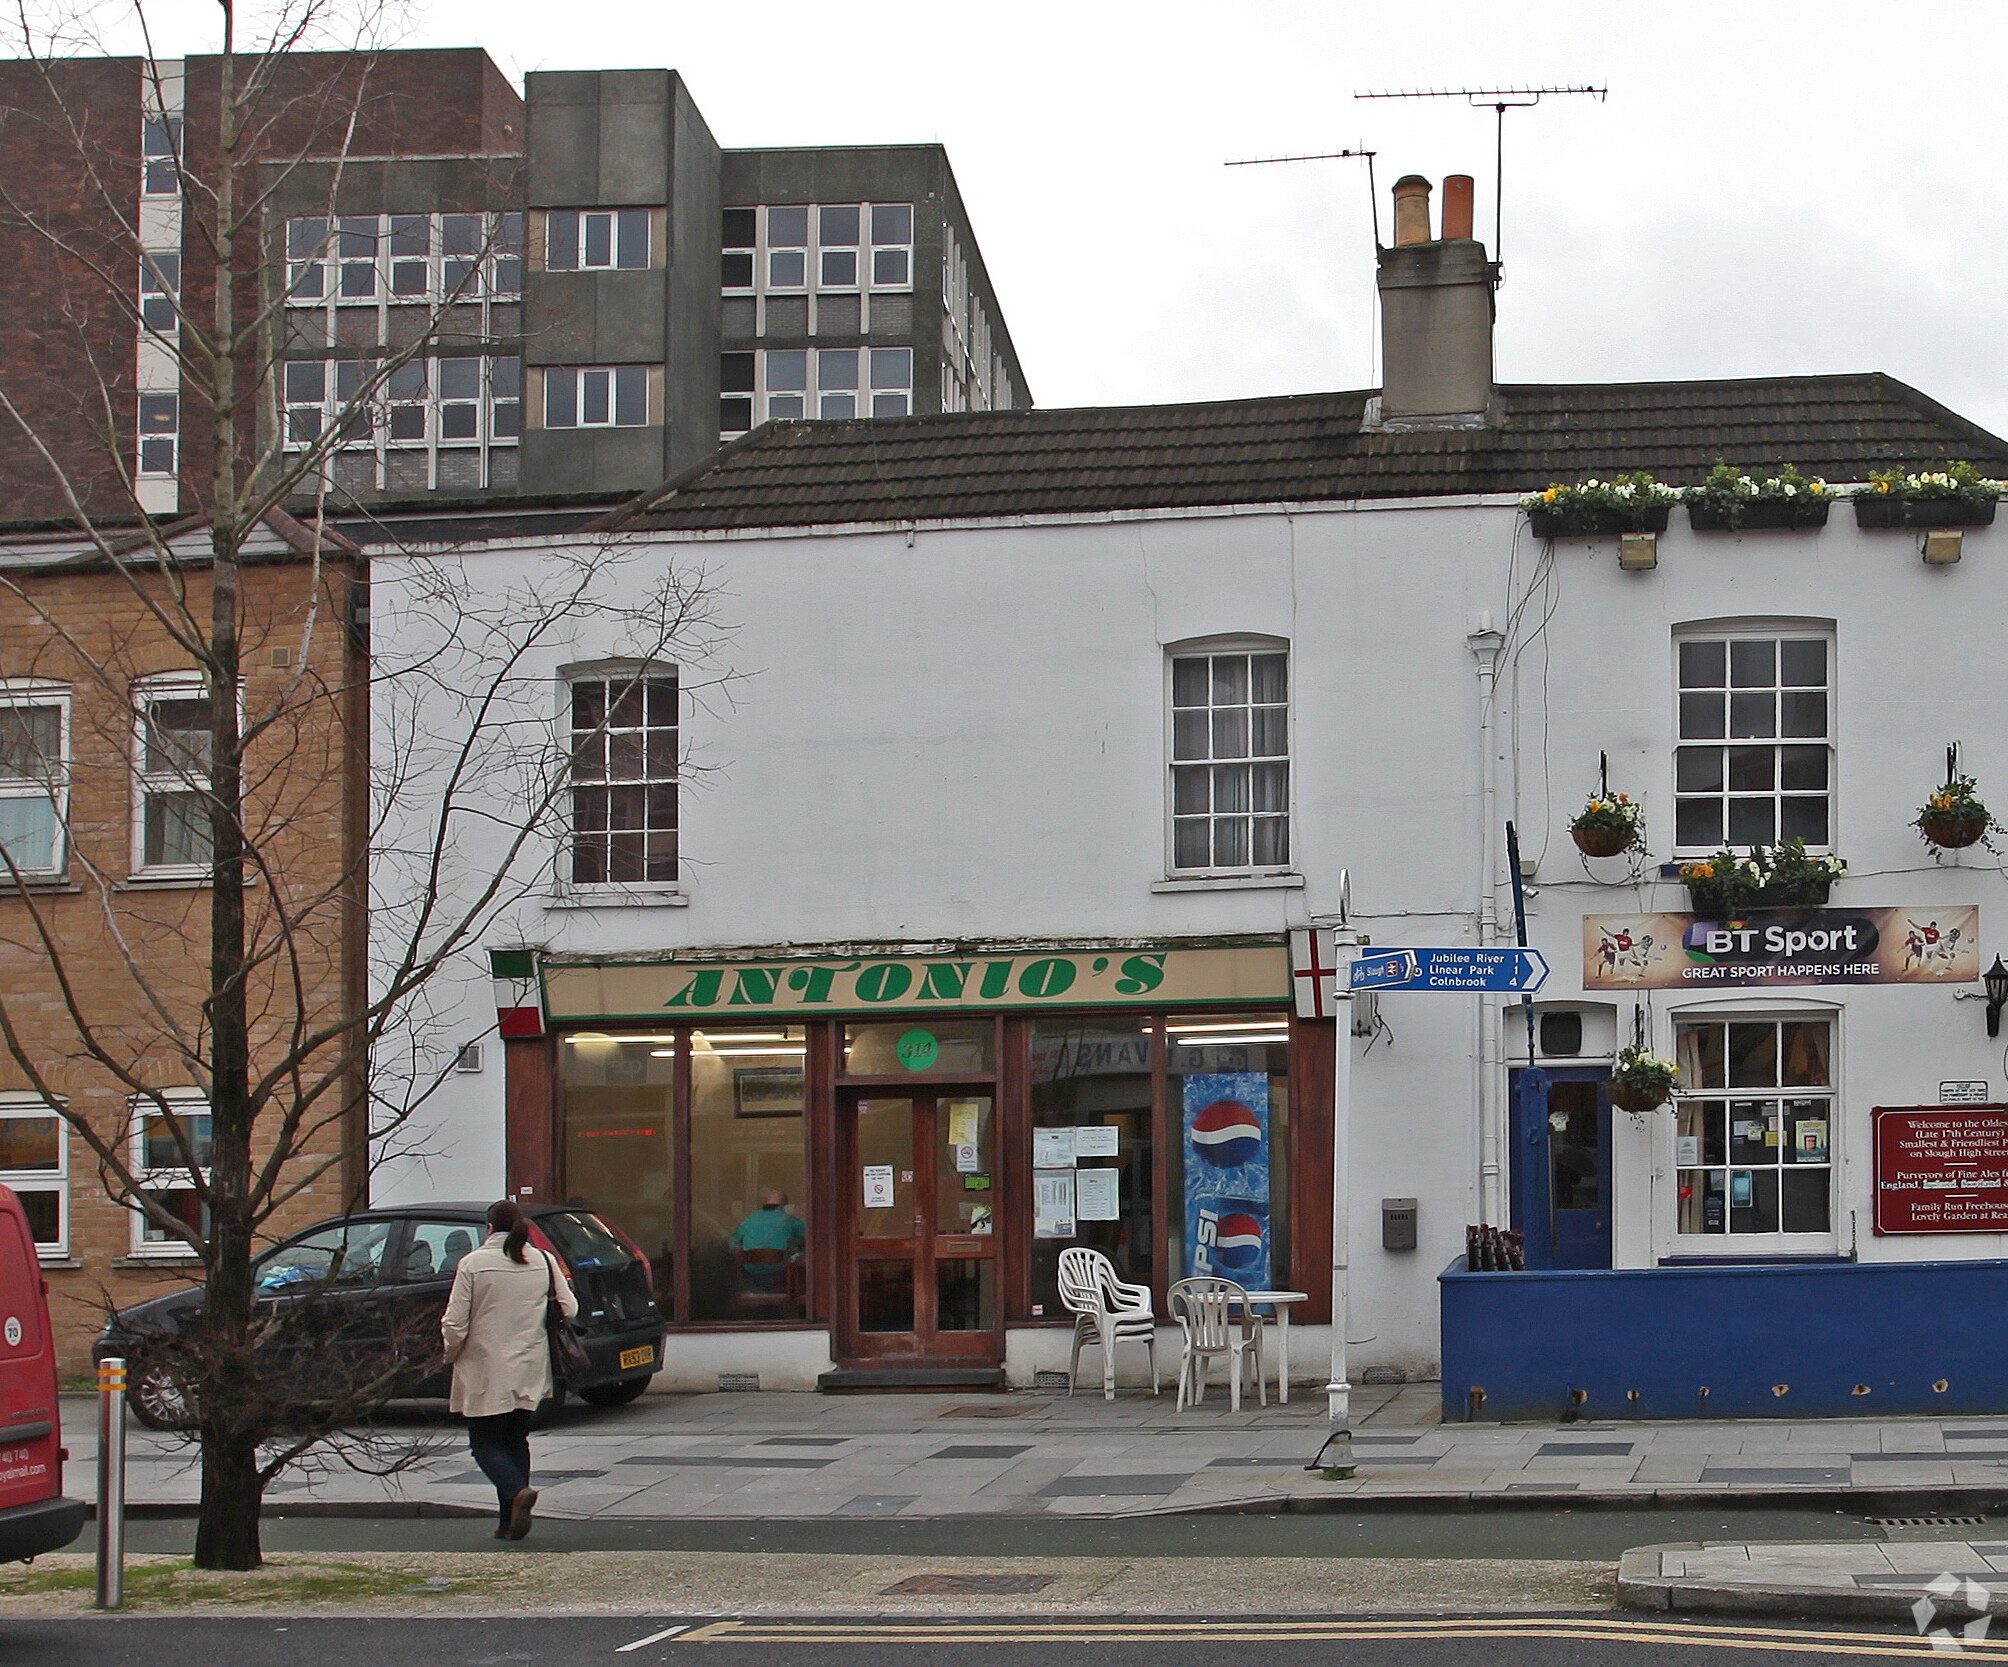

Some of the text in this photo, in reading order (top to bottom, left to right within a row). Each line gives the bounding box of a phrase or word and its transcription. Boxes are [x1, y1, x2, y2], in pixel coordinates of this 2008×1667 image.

[1706, 925, 1857, 957] BT Sport
[1429, 954, 1519, 963] Jubilee River 1
[1429, 966, 1519, 975] Linear Park 1
[1682, 963, 1880, 979] GREAT SPORT HAPPENS HERE
[662, 952, 1168, 1007] ANTONIO'S
[1429, 977, 1518, 987] Colnbrook 4
[901, 1042, 932, 1058] 314
[1908, 1120, 1950, 1129] Welcome
[1952, 1120, 1963, 1128] to
[1965, 1120, 1979, 1128] the
[1915, 1129, 2005, 1139] (Late 17th Century)
[1899, 1140, 1938, 1148] Smallest
[1940, 1140, 1948, 1148] &
[1951, 1139, 2000, 1147] Friendliest
[1925, 1149, 1956, 1158] Slough
[1959, 1149, 1981, 1158] High
[1897, 1171, 1943, 1180] Purveyors
[1945, 1171, 1955, 1179] of
[1958, 1170, 1977, 1178] Fine
[1980, 1170, 2000, 1178] Ales
[1911, 1203, 1941, 1212] Family
[1944, 1202, 1963, 1210] Run
[1911, 1212, 1941, 1222] Lovely
[1943, 1212, 1978, 1220] Garden
[1979, 1212, 1989, 1220] at
[1191, 1208, 1220, 1277] PSI
[8, 1327, 19, 1338] 70
